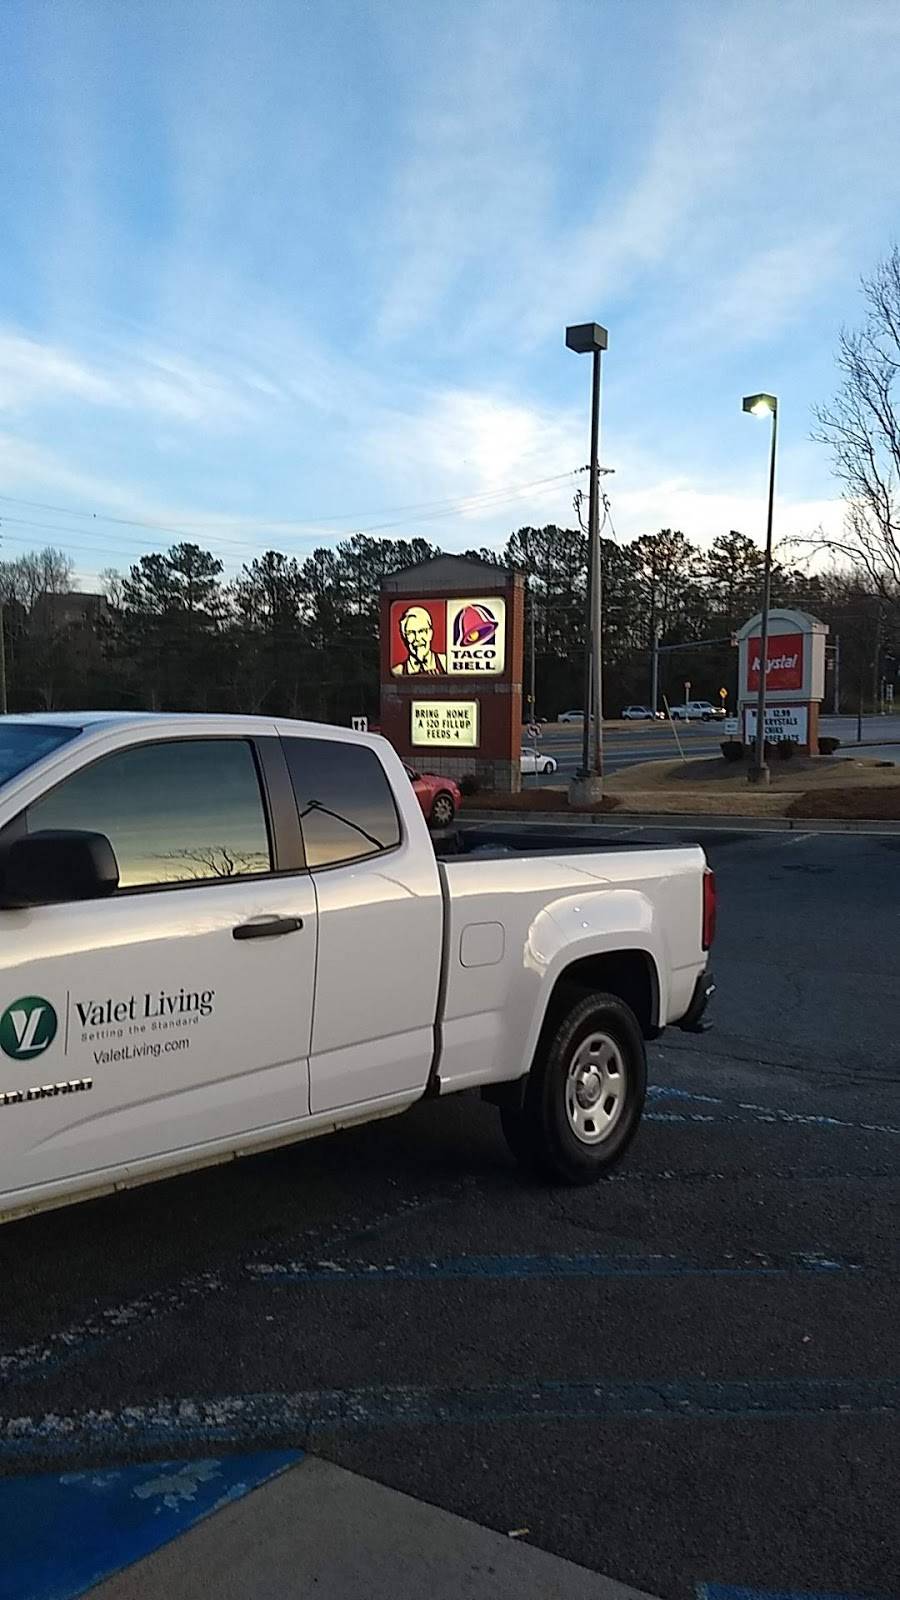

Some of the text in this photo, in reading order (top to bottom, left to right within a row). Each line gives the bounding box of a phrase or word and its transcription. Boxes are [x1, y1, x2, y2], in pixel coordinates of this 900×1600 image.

[451, 650, 496, 659] TACO
[452, 662, 496, 671] BELL
[752, 654, 798, 674] Kystal
[415, 709, 439, 718] BRING
[418, 719, 424, 728] A
[442, 719, 471, 729] FILLUP
[427, 729, 460, 739] FEEDS 4
[76, 988, 213, 1027] Valet Living
[9, 1006, 49, 1052] VL
[81, 1015, 200, 1042] Setting the Standard
[93, 1037, 190, 1065] ValetLiving.com
